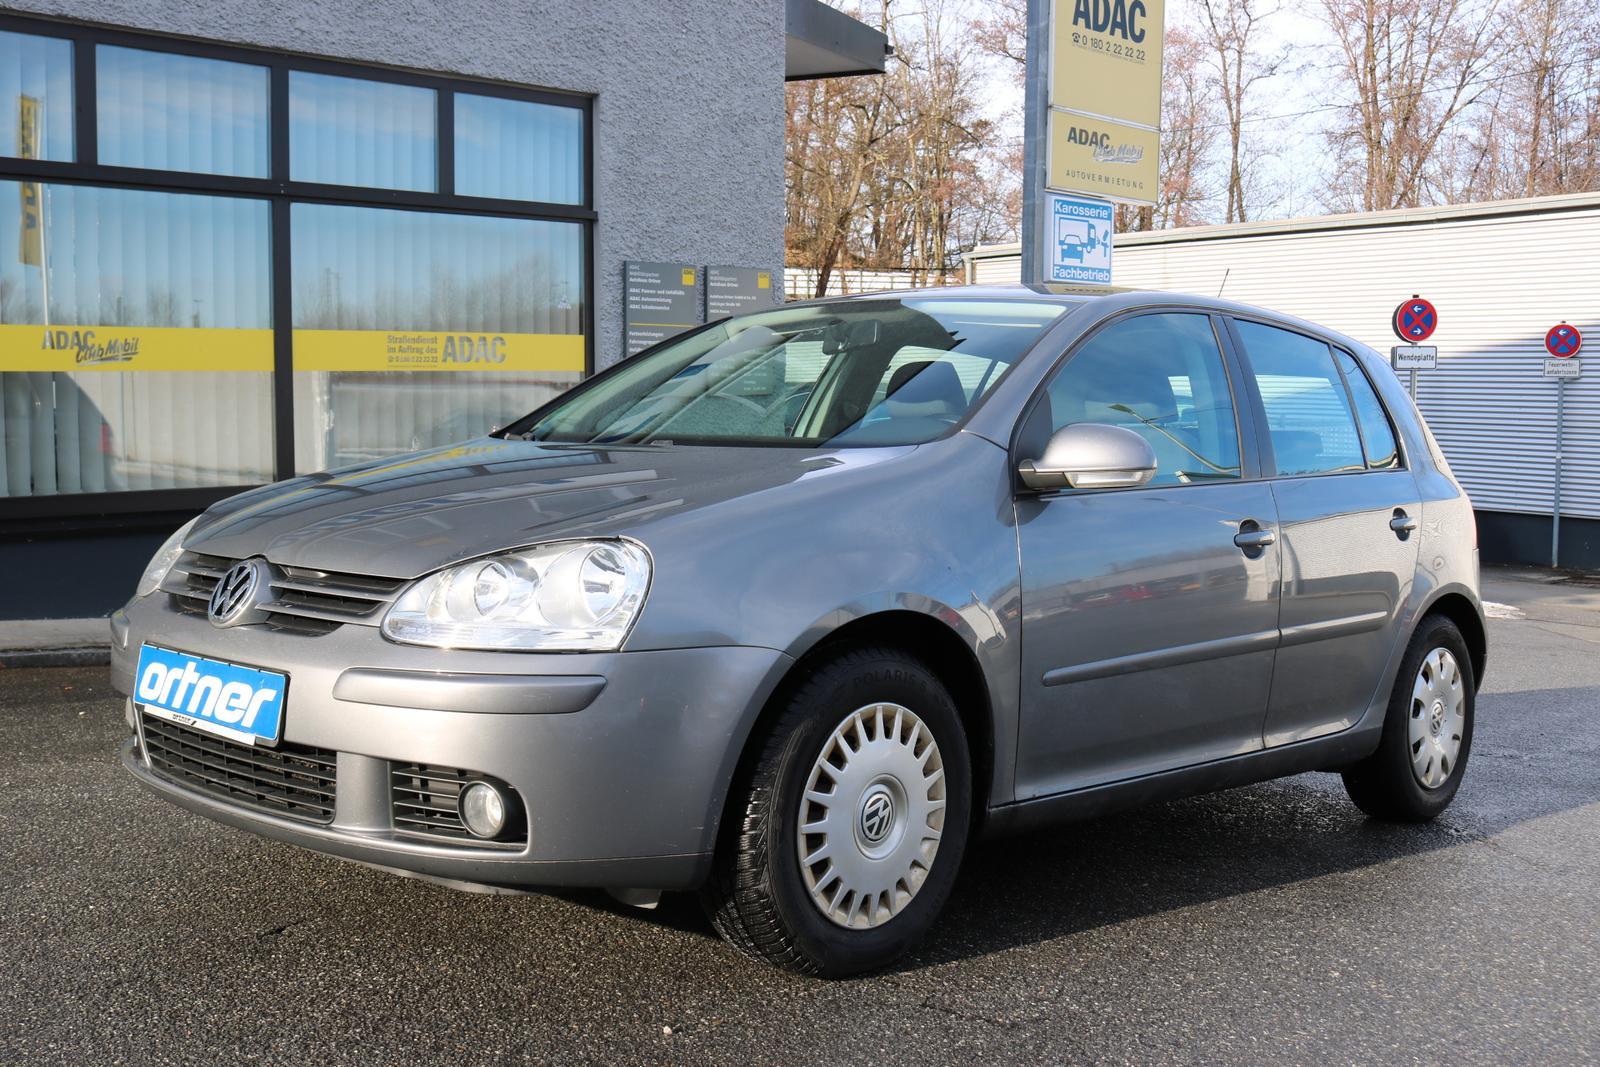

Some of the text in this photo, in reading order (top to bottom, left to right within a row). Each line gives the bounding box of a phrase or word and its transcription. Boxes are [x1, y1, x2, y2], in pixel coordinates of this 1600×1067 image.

[1072, 0, 1146, 43] ADAC
[1082, 35, 1088, 45] 0
[1090, 38, 1104, 50] 180
[1106, 42, 1111, 52] 2
[1113, 44, 1122, 55] 22
[1125, 47, 1134, 58] 22
[1136, 50, 1145, 60] 22
[1067, 127, 1110, 150] ADAC
[1066, 169, 1144, 190] AUTOVERMIETUNG
[1055, 201, 1108, 218] Karosserie
[1054, 266, 1110, 281] Fachbetrieb
[42, 330, 95, 350] ADAC
[105, 337, 139, 356] Mobil
[387, 335, 437, 344] Straßendienst
[441, 335, 506, 363] ADAC
[1398, 353, 1434, 362] Wendeplatte
[138, 661, 278, 728] ortner
